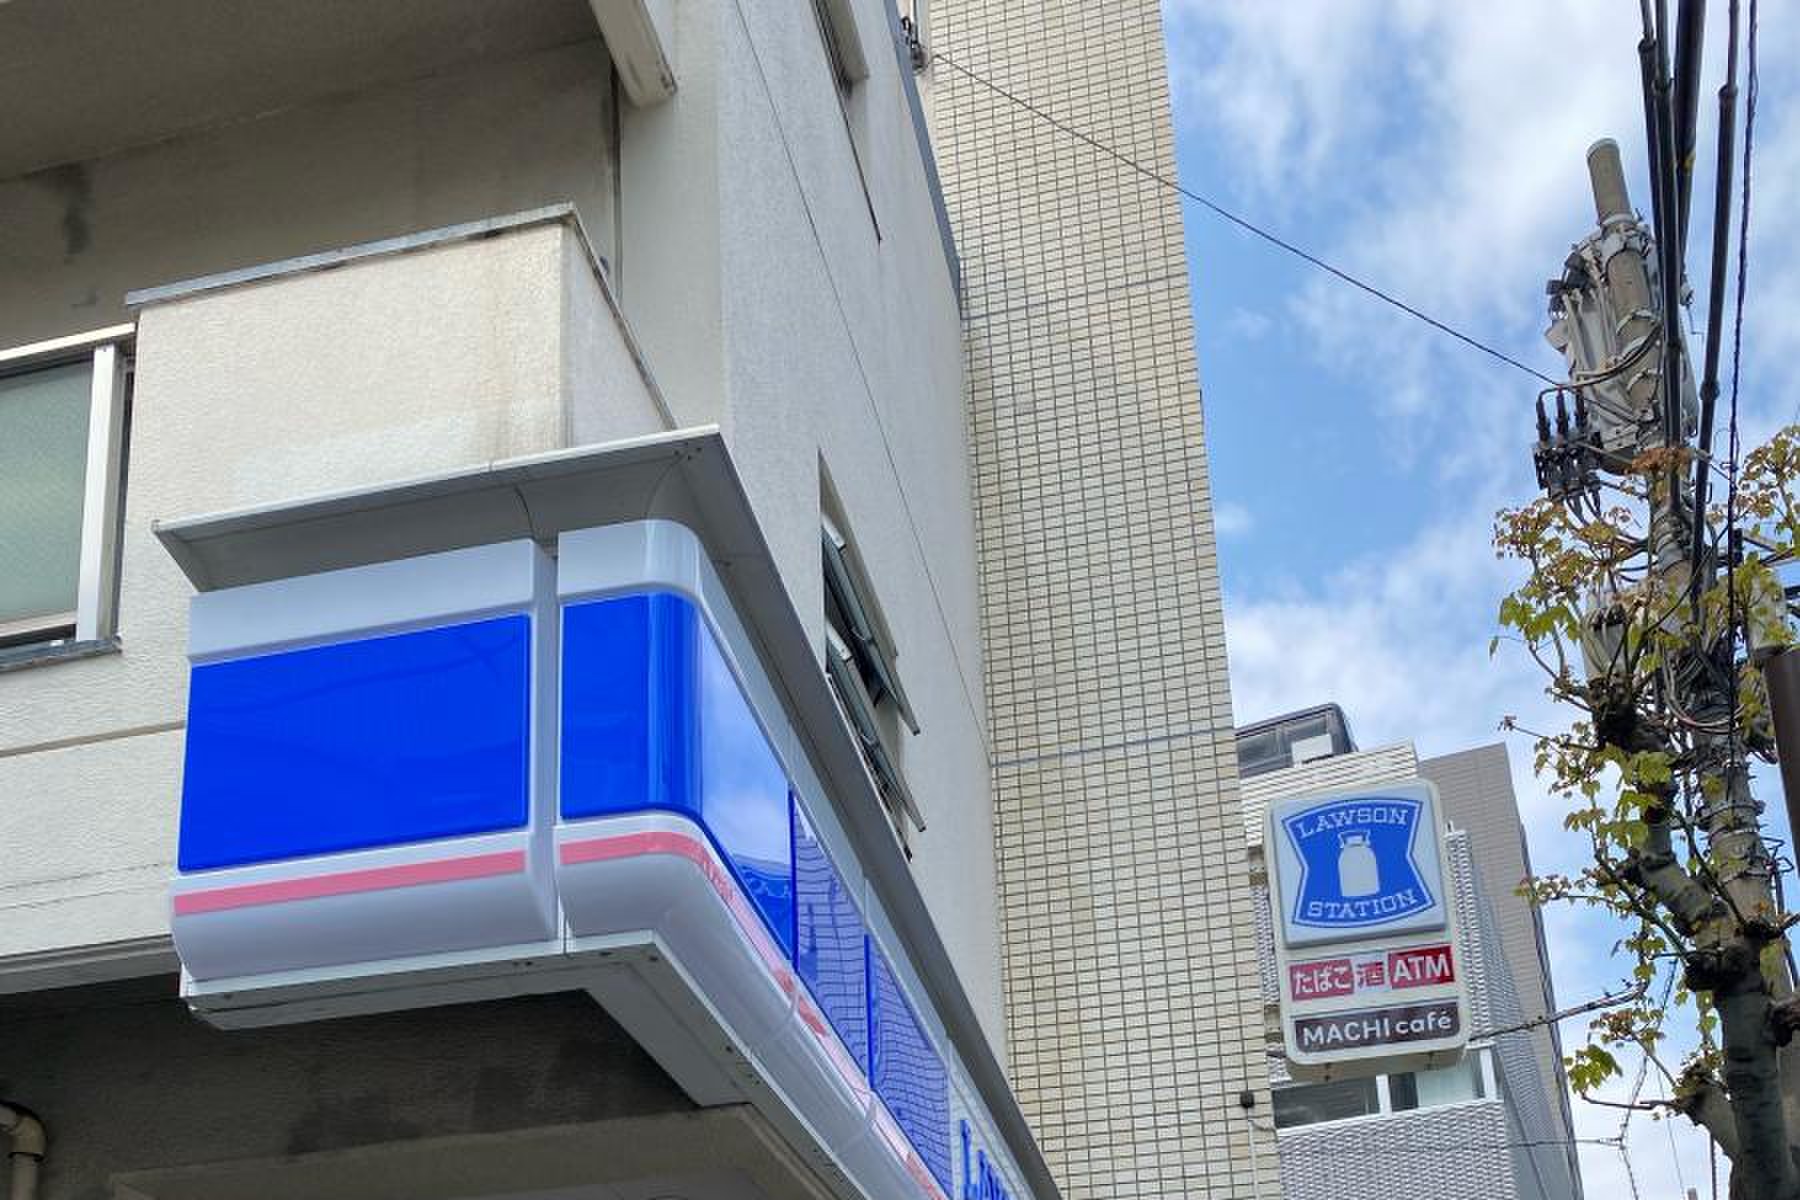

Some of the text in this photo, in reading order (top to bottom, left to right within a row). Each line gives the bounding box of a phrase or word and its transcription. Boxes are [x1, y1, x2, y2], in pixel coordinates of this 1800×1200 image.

[1296, 807, 1408, 838] LAWSON
[1307, 888, 1417, 919] STATION
[1295, 966, 1351, 995] たばこ
[1393, 953, 1450, 983] ATM
[1303, 1010, 1452, 1046] MACHI café
